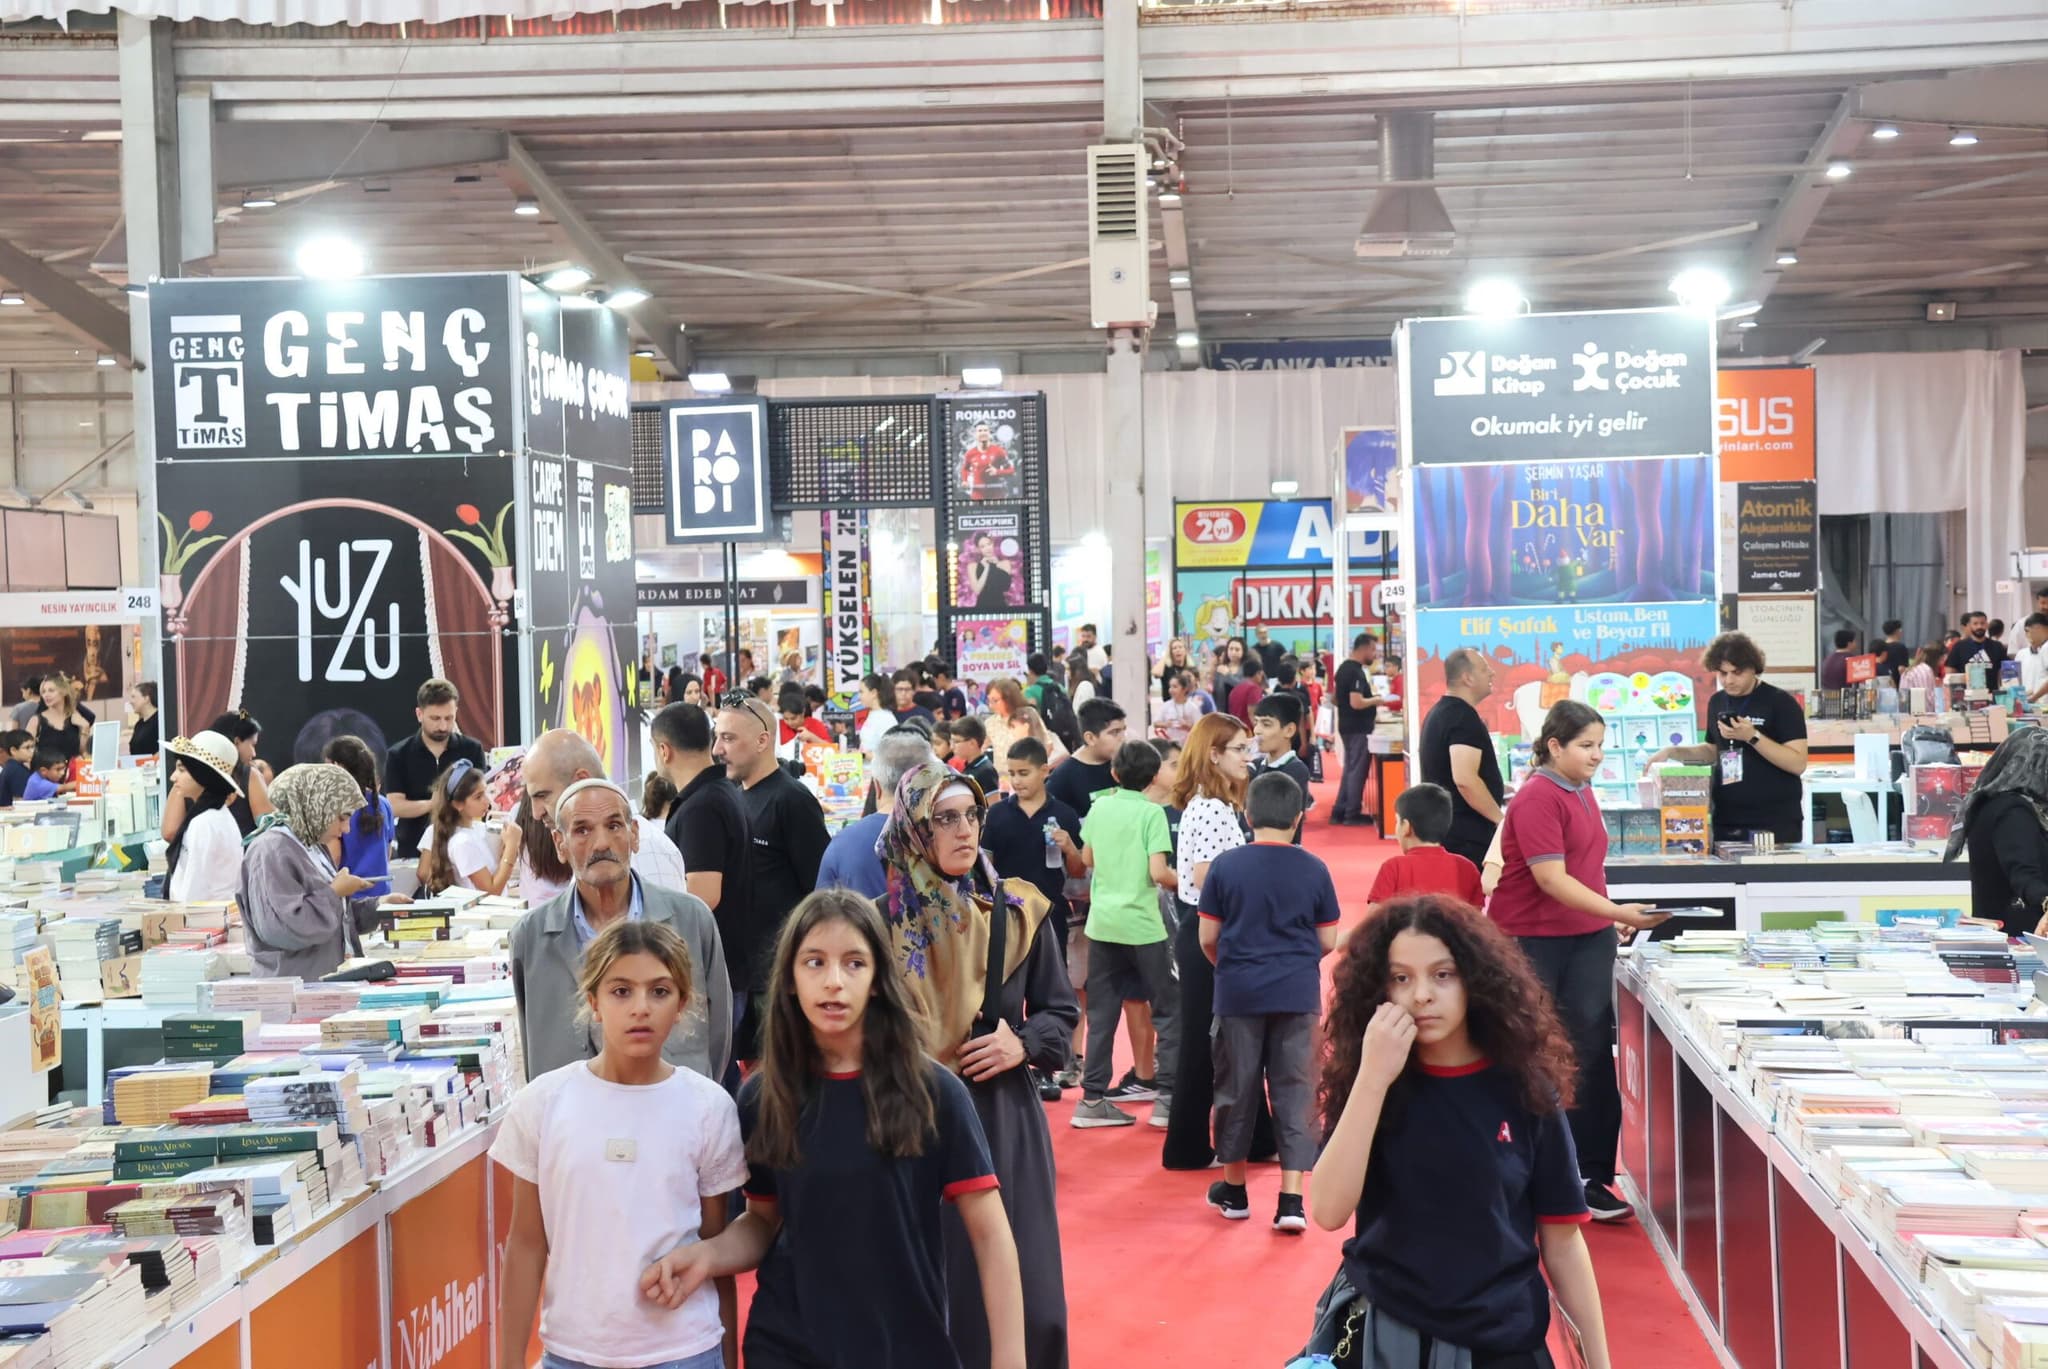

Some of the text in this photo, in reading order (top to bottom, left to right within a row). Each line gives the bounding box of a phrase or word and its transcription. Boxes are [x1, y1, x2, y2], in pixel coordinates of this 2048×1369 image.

[169, 336, 246, 360] GENÇ
[264, 308, 490, 377] GENÇ
[1491, 354, 1557, 375] Doğan
[1615, 350, 1687, 372] Doğan
[1492, 378, 1545, 397] Kitap
[1615, 368, 1680, 394] Çocuk
[266, 385, 495, 453] TİMAŞ
[955, 409, 1016, 420] RONALDO
[1471, 410, 1648, 438] Okumak iyi gelir
[532, 459, 562, 506] CARPE
[1568, 464, 1604, 480] YAŞAR
[1511, 497, 1605, 528] Daha
[1741, 498, 1812, 518] Atomik
[1196, 518, 1234, 541] 20
[1779, 570, 1801, 578] Clear
[1385, 585, 1405, 596] 249
[128, 596, 151, 608] 248
[836, 550, 859, 684] YÜKSELEN
[1634, 607, 1668, 622] Ben
[1460, 615, 1558, 638] Elif Şafak
[1572, 622, 1671, 641] ve Beyaz Fil
[963, 662, 990, 672] BOYA
